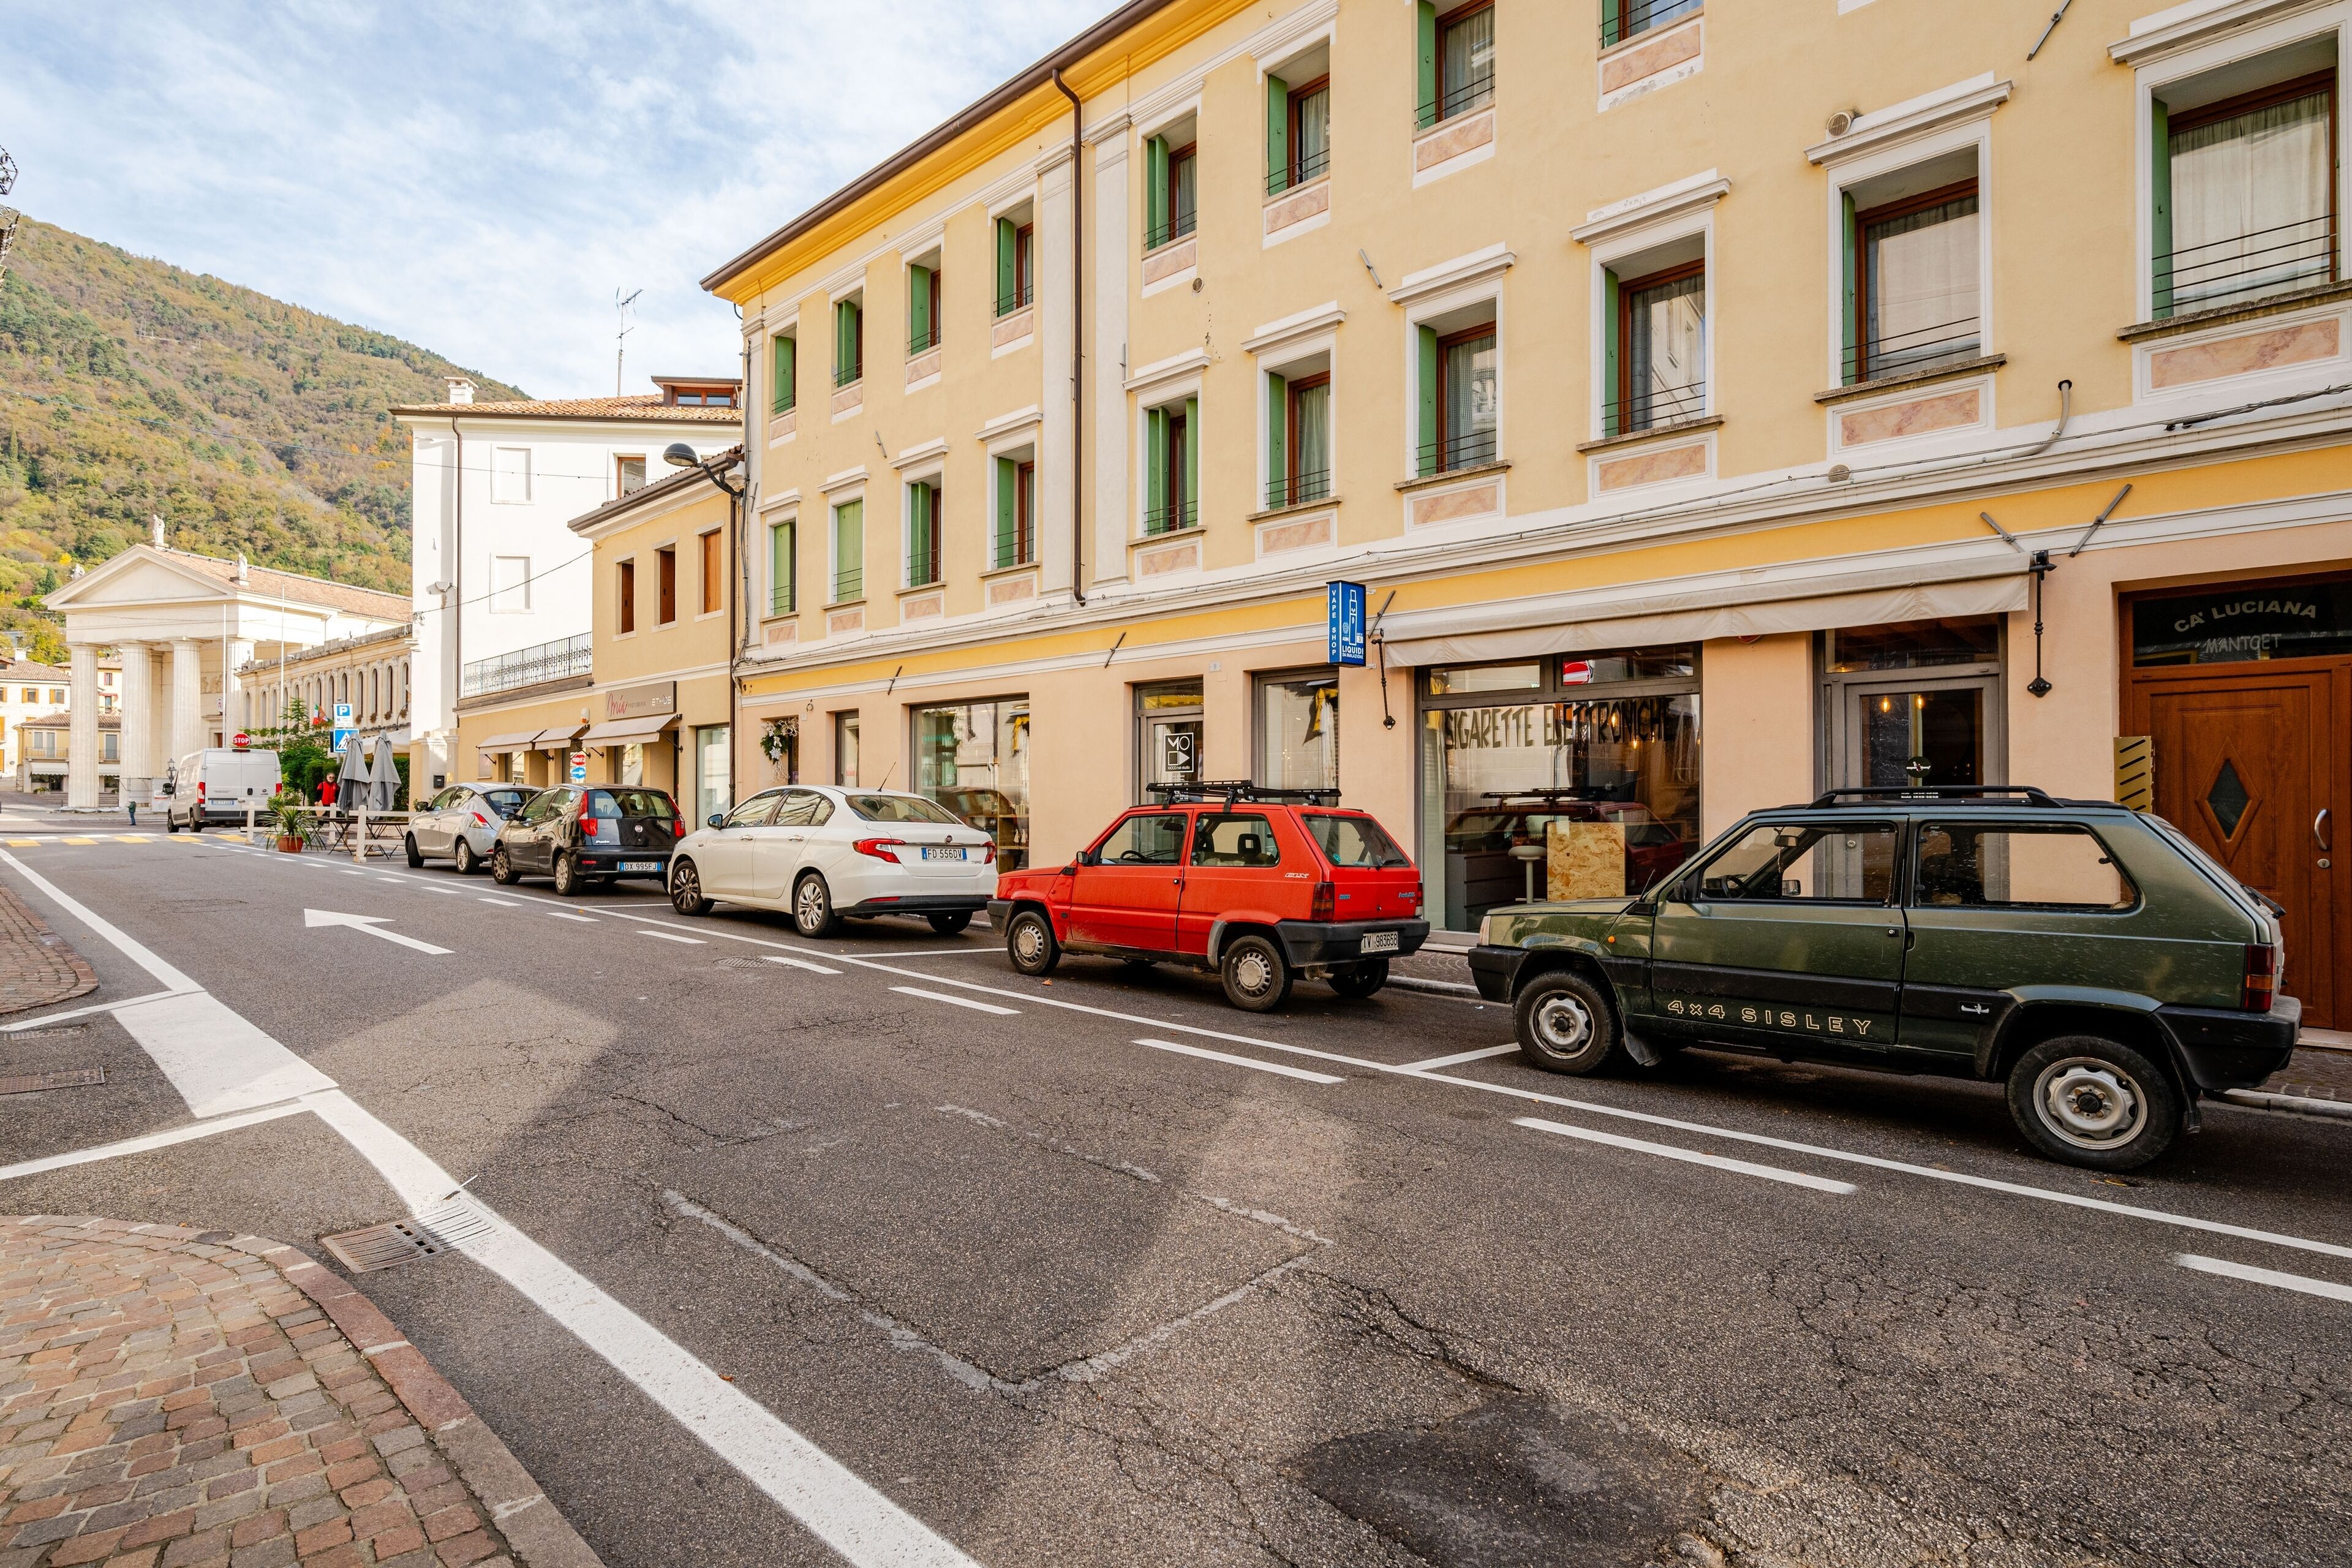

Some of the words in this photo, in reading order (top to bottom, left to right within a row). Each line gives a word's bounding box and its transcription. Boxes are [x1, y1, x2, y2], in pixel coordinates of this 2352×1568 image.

[2211, 600, 2316, 619] LUCIANA
[1342, 645, 1363, 655] LIQUIDI
[339, 706, 348, 715] P
[1444, 706, 1534, 750] SIGARETTE
[927, 849, 937, 858] FD
[940, 849, 962, 858] 556DV
[1363, 935, 1371, 948] TV
[1376, 933, 1398, 947] 983658
[1741, 1008, 1871, 1035] SISLEY
